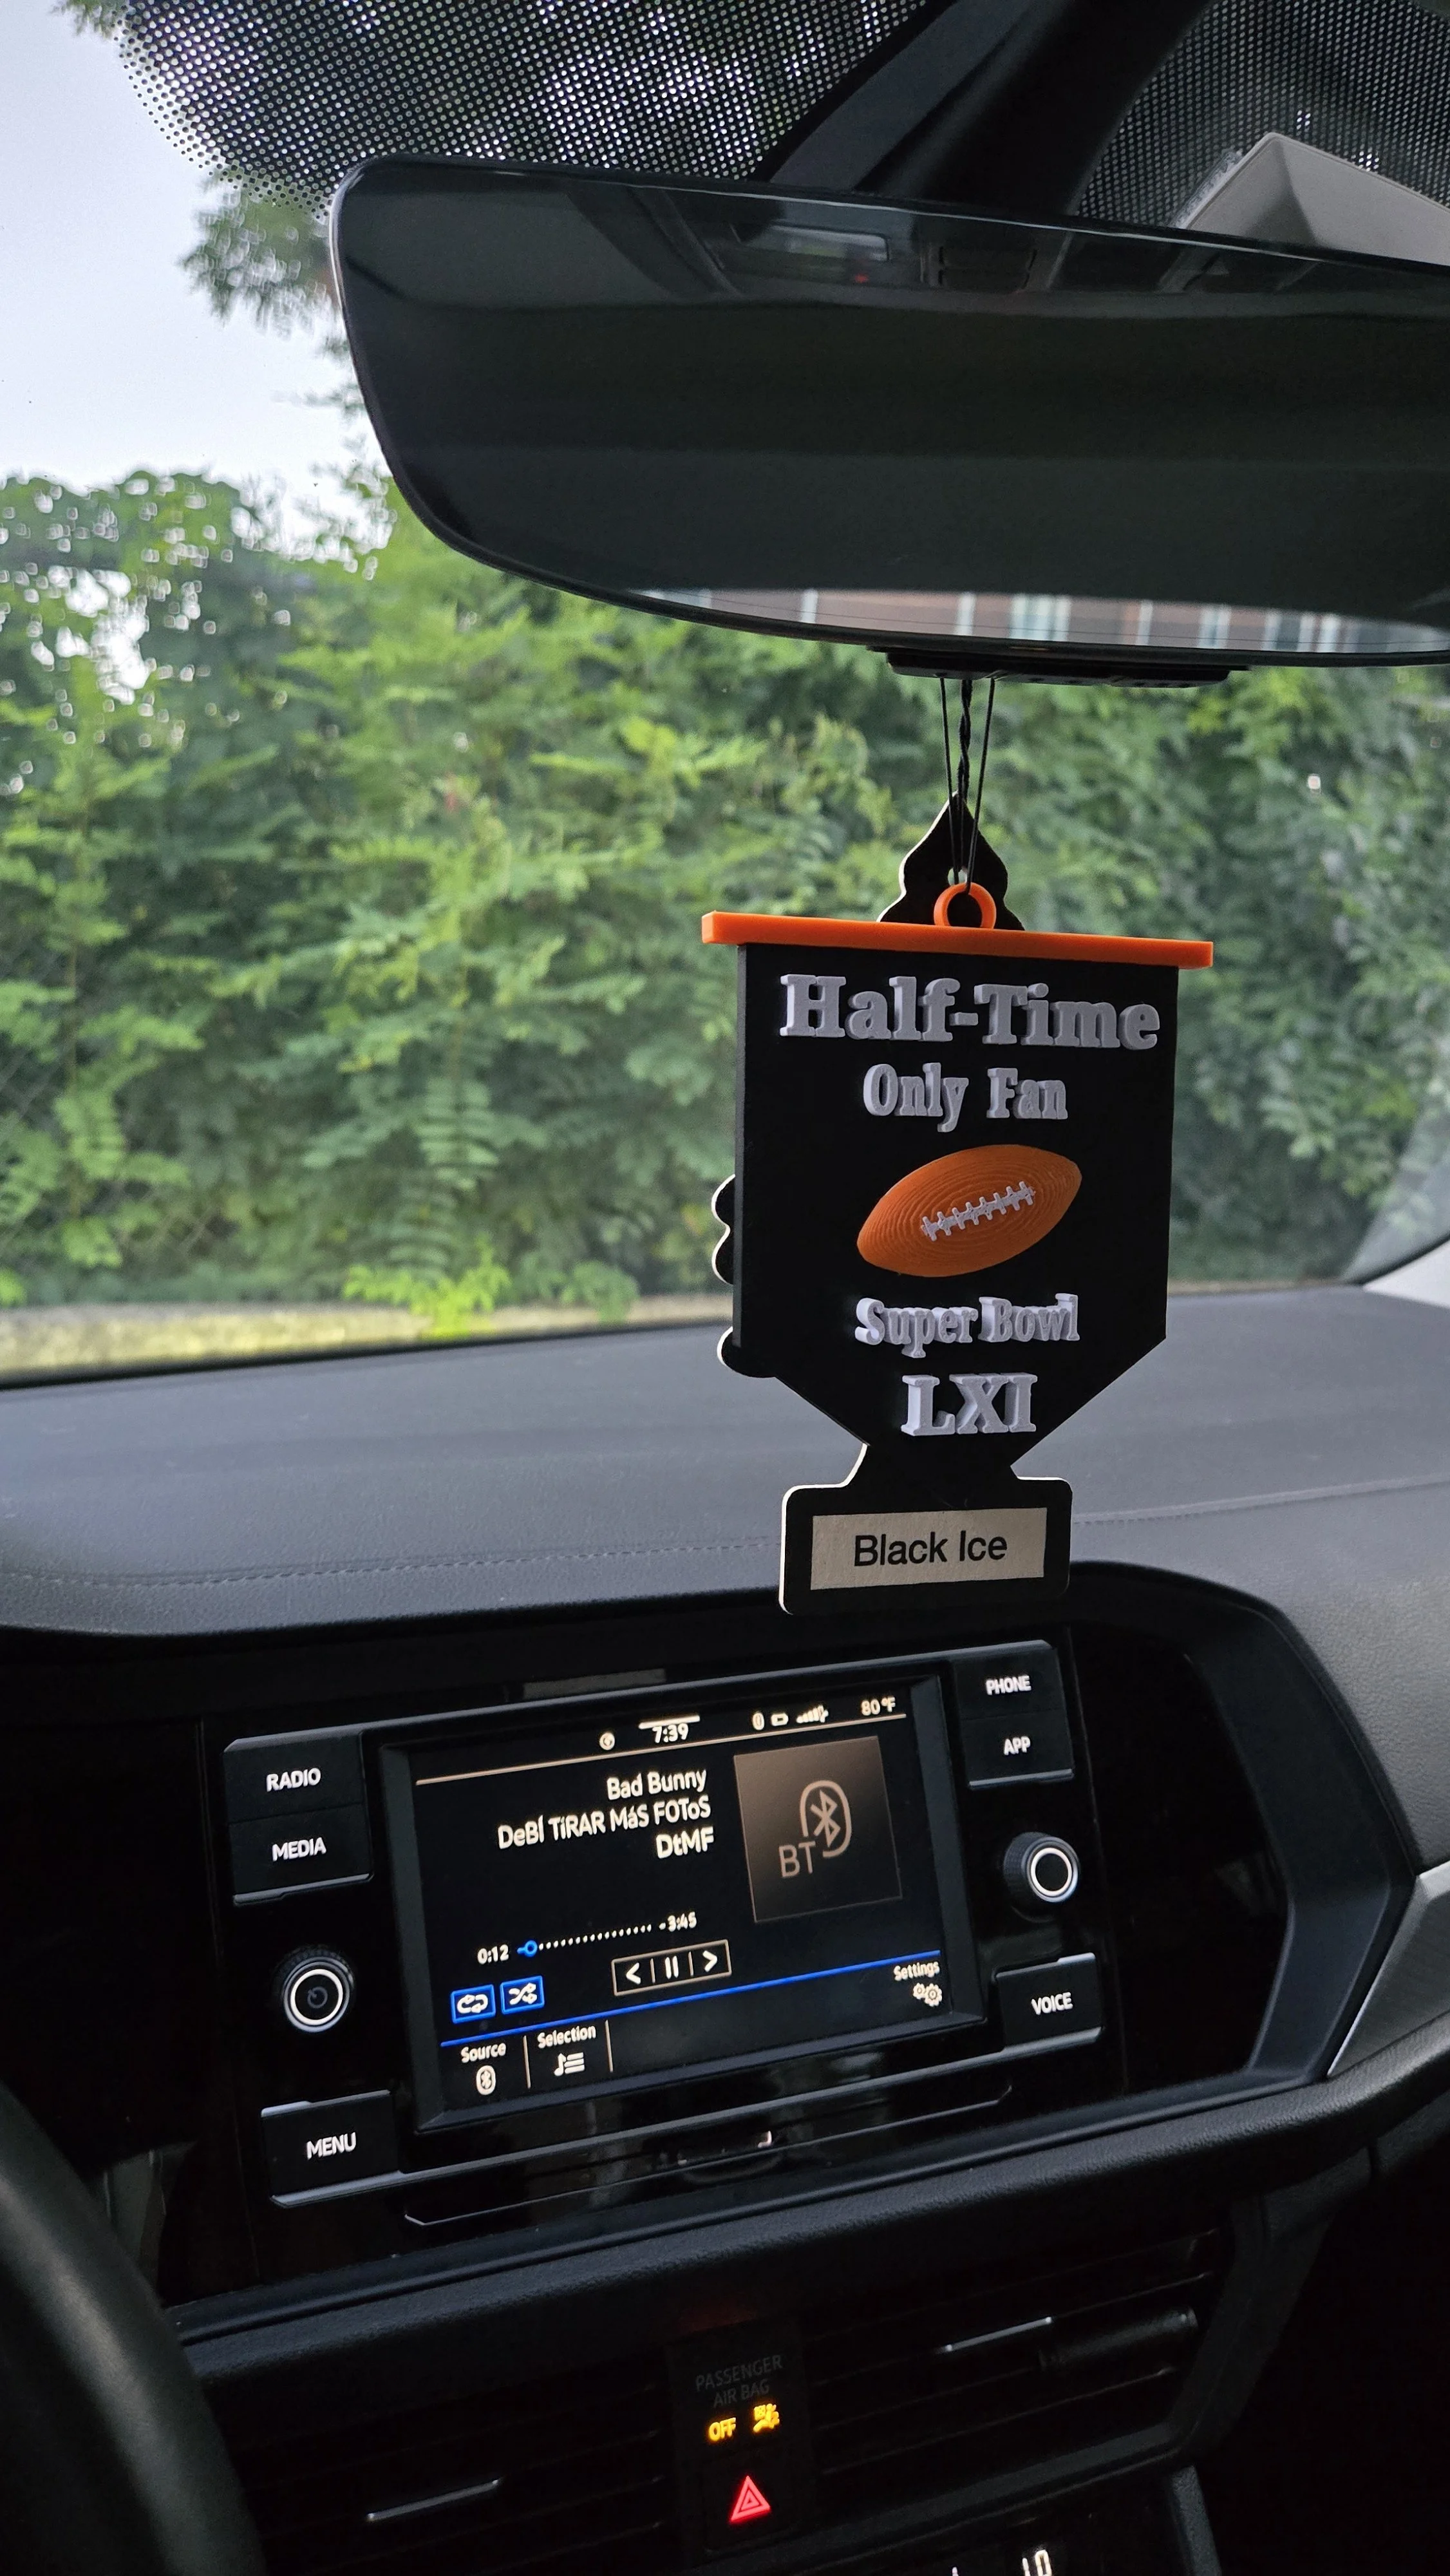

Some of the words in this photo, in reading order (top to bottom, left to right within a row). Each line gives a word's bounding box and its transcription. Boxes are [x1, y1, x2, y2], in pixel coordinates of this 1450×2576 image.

[780, 974, 1160, 1049] Half-Time
[863, 1063, 968, 1132] Only
[987, 1068, 1068, 1119] Fan
[854, 1298, 978, 1358] Super
[978, 1293, 1080, 1342] Bowl
[901, 1372, 1037, 1436] LXI
[854, 1531, 947, 1566] Black
[959, 1530, 1008, 1561] Ice
[986, 1675, 1031, 1695] PHONE
[652, 1723, 688, 1743] 7:39
[1004, 1736, 1030, 1755] APP
[267, 1768, 321, 1792] RADIO
[607, 1773, 643, 1800] Bad
[647, 1770, 707, 1793] Bunny
[272, 1837, 326, 1861] MEDIA
[655, 1826, 713, 1859] DtMF
[779, 1841, 815, 1877] BT
[478, 1944, 509, 1964] 0:12
[894, 1962, 940, 1981] Settings
[1031, 1992, 1073, 2014] VOICE
[537, 2025, 596, 2049] Selection
[460, 2042, 507, 2061] Source
[306, 2132, 356, 2159] MENU
[695, 2354, 783, 2392] PASSENGER
[713, 2388, 737, 2409] AIR
[741, 2378, 770, 2400] BAG
[708, 2418, 736, 2441] OFF
